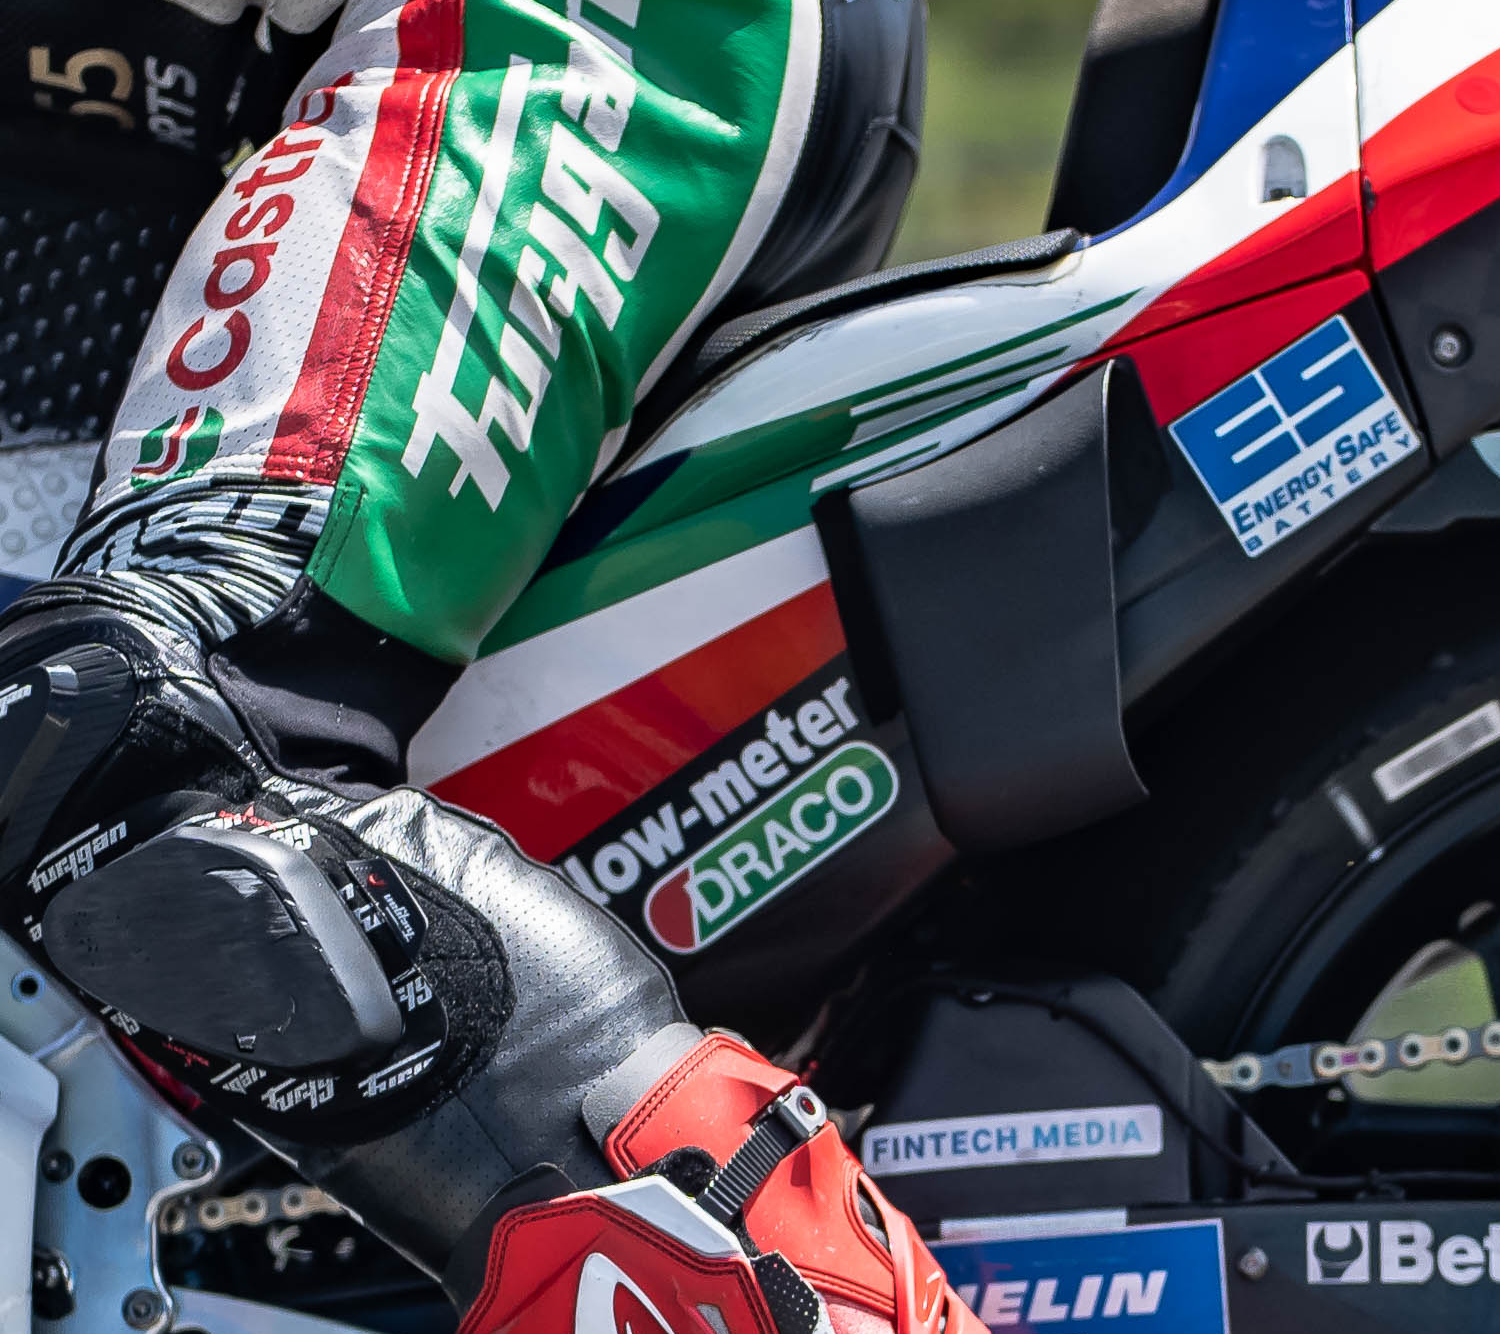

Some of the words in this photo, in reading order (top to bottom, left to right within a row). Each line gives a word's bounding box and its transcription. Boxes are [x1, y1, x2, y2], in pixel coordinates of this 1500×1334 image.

[564, 678, 859, 906] low-meter
[685, 765, 874, 925] DRACO
[872, 1127, 1017, 1165] FINTECH
[1032, 1119, 1144, 1152] MEDIA
